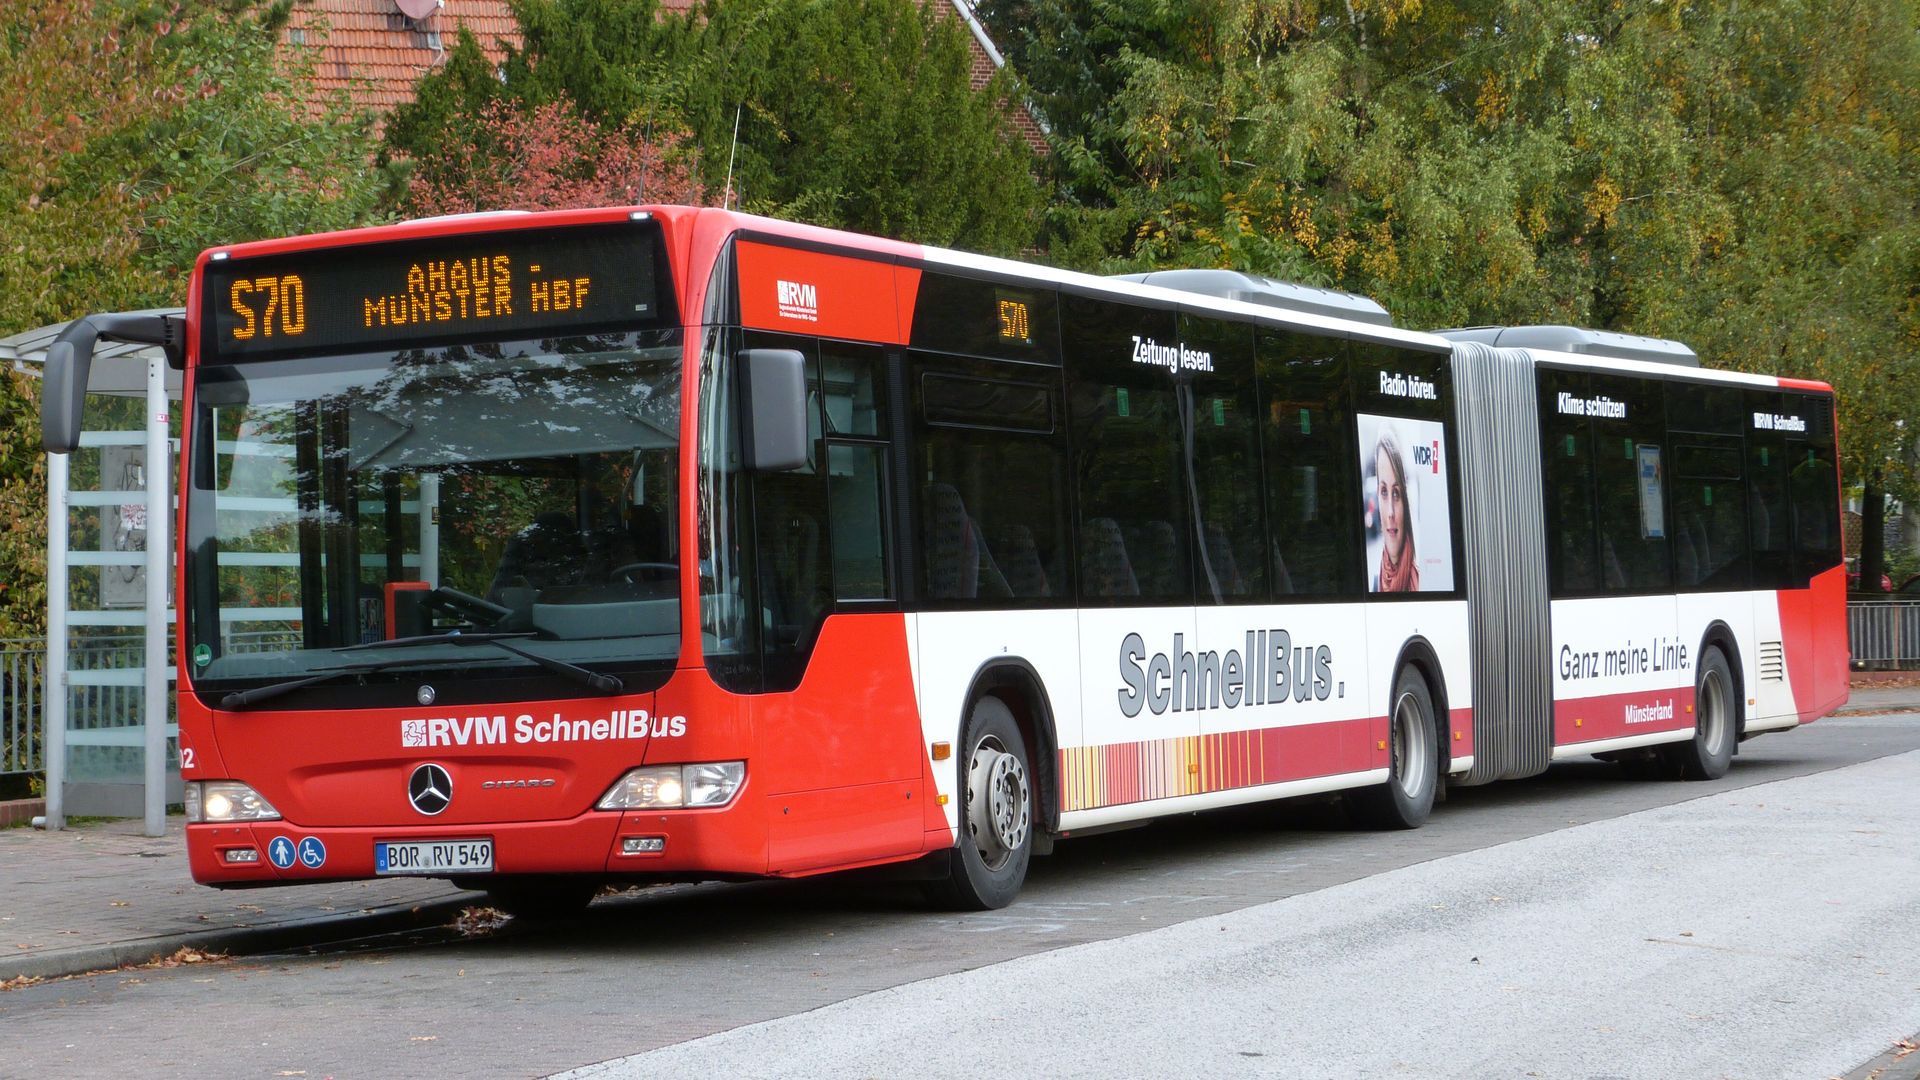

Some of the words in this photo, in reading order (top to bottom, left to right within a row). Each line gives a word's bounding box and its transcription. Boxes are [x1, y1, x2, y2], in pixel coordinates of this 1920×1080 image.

[407, 255, 511, 293] AHAUS
[231, 275, 305, 340] S70
[364, 284, 512, 327] MÜNSTER
[531, 277, 590, 312] HBF
[788, 281, 817, 308] RVM
[1001, 300, 1029, 340] S70
[1132, 336, 1178, 373] Zeitung
[1180, 343, 1214, 372] lesen.
[1380, 371, 1406, 396] Radio
[1408, 375, 1436, 400] hören.
[1558, 392, 1584, 415] Klima
[1585, 396, 1626, 418] schützen
[1413, 446, 1432, 465] WDR
[1118, 629, 1345, 718] SchnellBus.
[1560, 644, 1599, 680] Ganz
[1604, 640, 1648, 676] meine
[1653, 636, 1691, 672] Linie.
[428, 717, 507, 746] RVM
[514, 709, 687, 744] SchnellBus
[1625, 699, 1673, 724] Münsterland
[482, 779, 555, 789] CITARO
[388, 846, 420, 868] BOR
[433, 846, 454, 866] RV
[459, 844, 490, 865] 549
